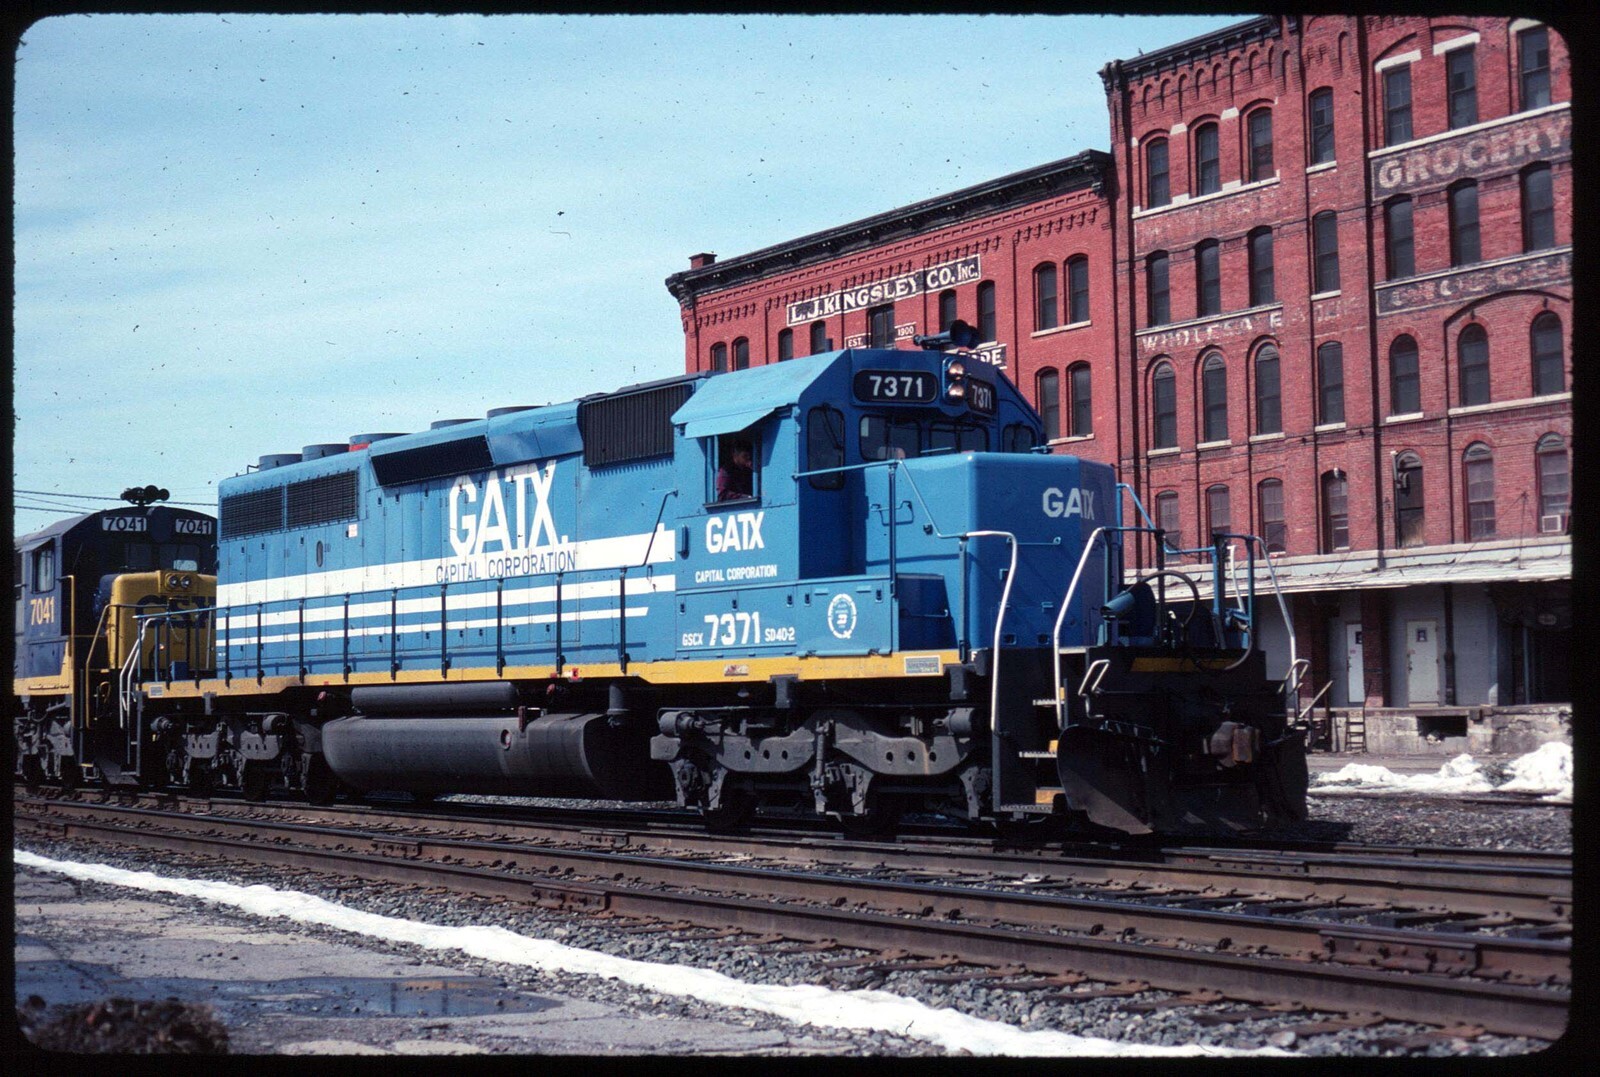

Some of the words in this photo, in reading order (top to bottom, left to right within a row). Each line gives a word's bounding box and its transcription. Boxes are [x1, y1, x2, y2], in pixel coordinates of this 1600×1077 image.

[926, 268, 956, 289] CO.
[897, 326, 915, 336] 1900
[869, 376, 923, 398] 7371
[972, 385, 993, 409] 7371
[1042, 487, 1095, 520] GATX
[104, 517, 146, 532] 7041
[178, 519, 211, 534] 7041
[705, 512, 765, 554] GATX
[436, 561, 481, 583] CAPITAL
[488, 550, 576, 579] CORPORATION
[695, 570, 725, 583] CAPITAL
[726, 564, 778, 580] CORPORATION
[30, 596, 55, 625] 7041
[682, 632, 703, 646] GSCX
[704, 611, 761, 646] 7371
